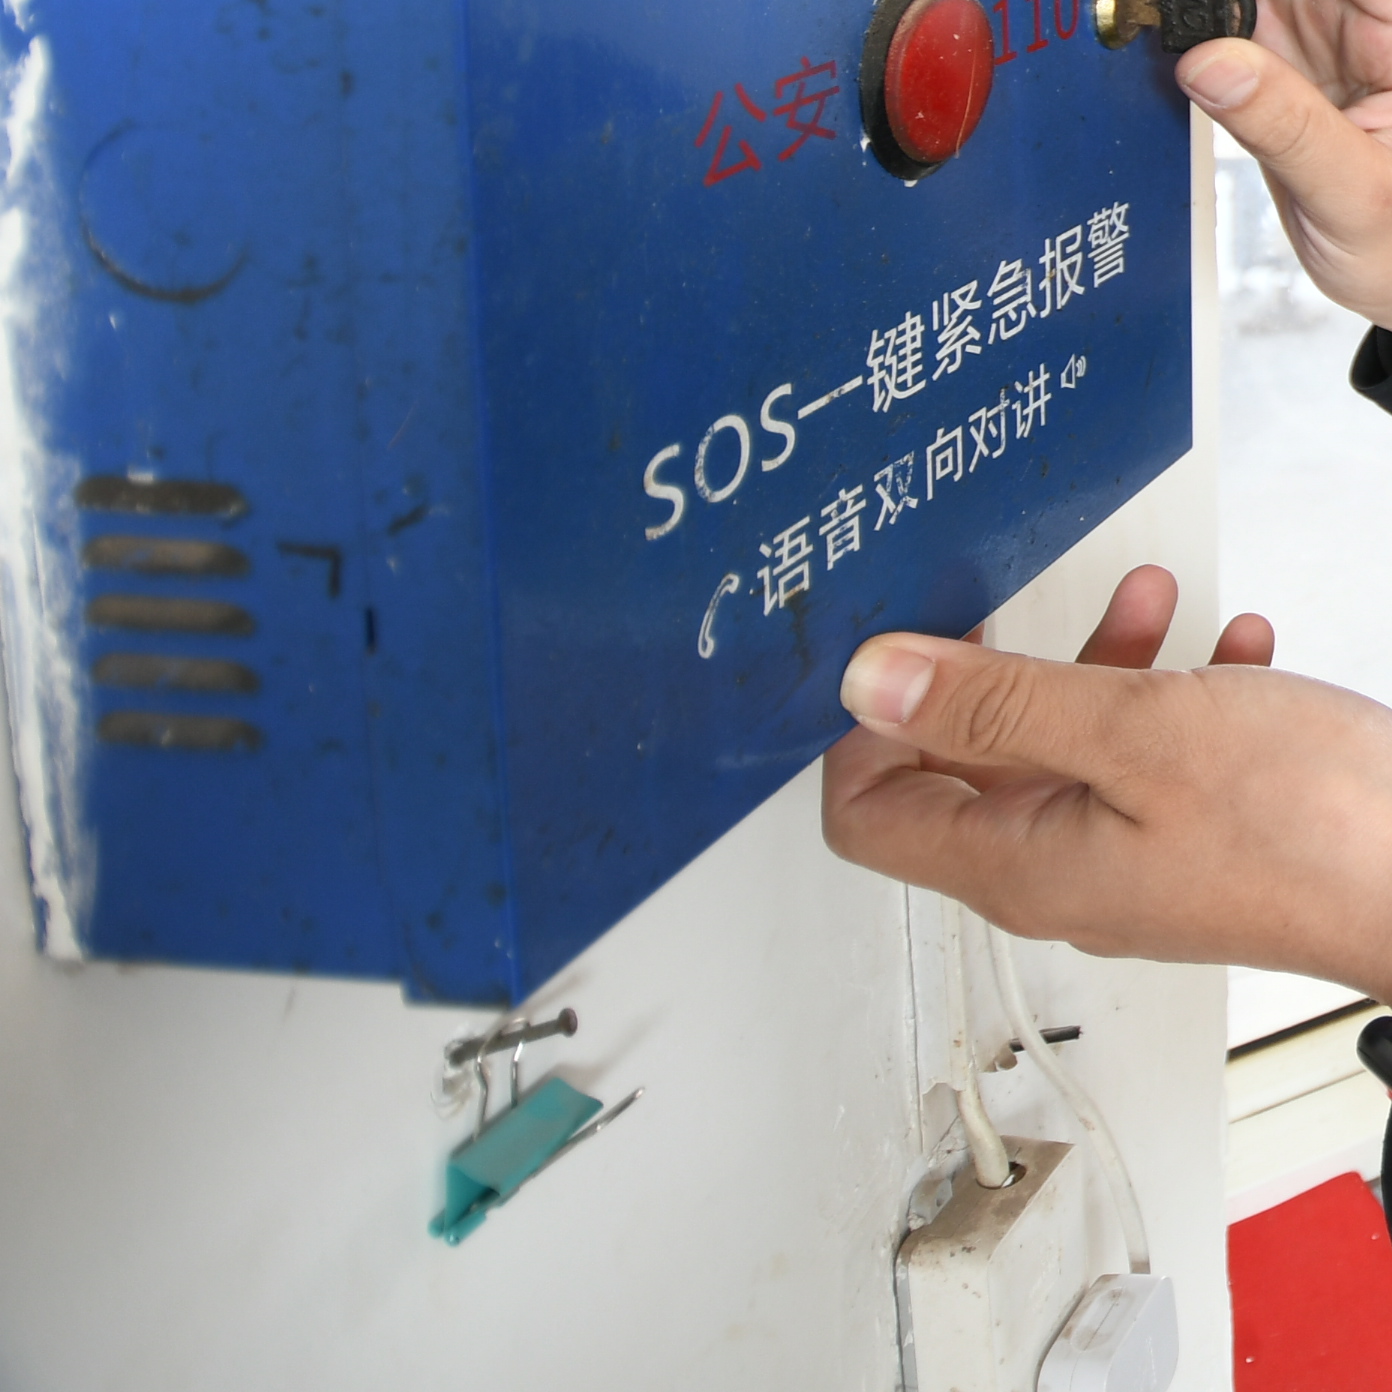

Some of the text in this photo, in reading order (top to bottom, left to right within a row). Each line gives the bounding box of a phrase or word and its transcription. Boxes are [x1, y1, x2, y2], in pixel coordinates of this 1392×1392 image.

[693, 57, 841, 187] 公安
[756, 363, 1052, 617] 语音双向对讲
